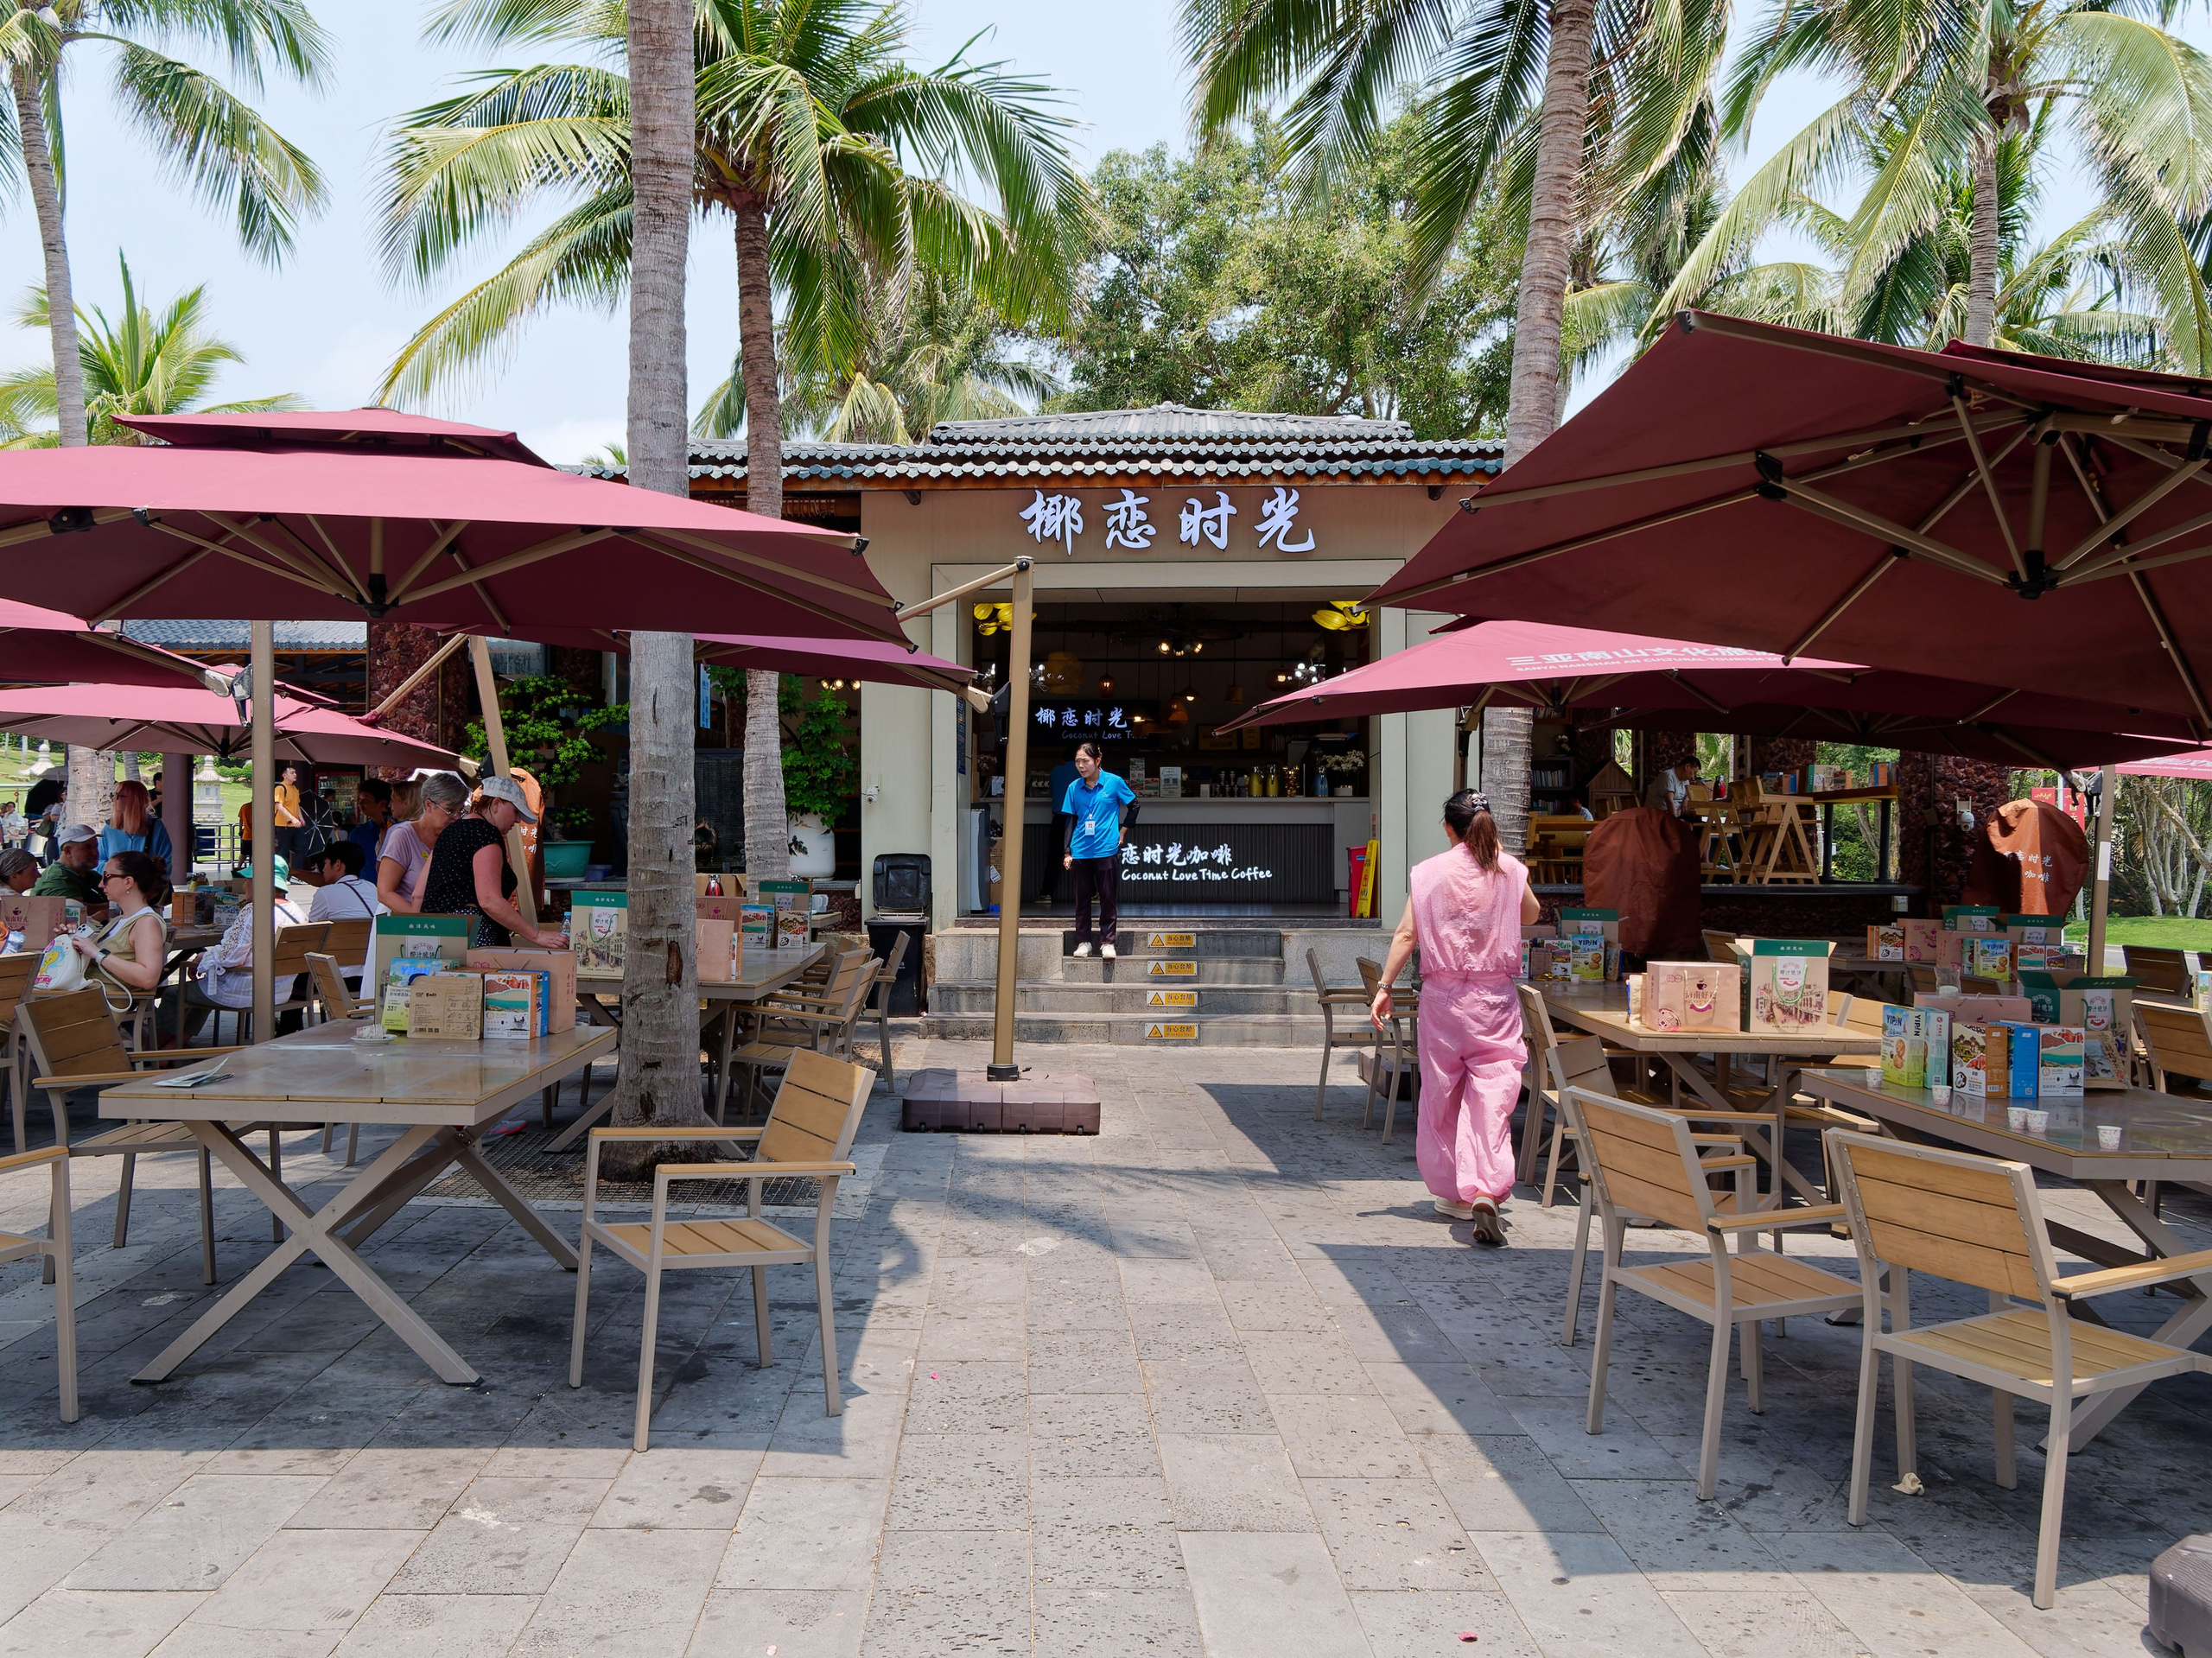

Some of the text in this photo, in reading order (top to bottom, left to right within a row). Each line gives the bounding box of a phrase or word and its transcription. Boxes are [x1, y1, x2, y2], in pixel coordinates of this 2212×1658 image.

[1019, 487, 1316, 556] 椰恋时光
[1560, 659, 1621, 669] NANSHAN
[1035, 707, 1128, 728] 椰恋时光
[1062, 730, 1098, 740] Coconut
[1102, 730, 1122, 740] Love
[1121, 842, 1233, 866] 恋时光咖啡
[1122, 867, 1273, 881] Coconut Love Time Coffee
